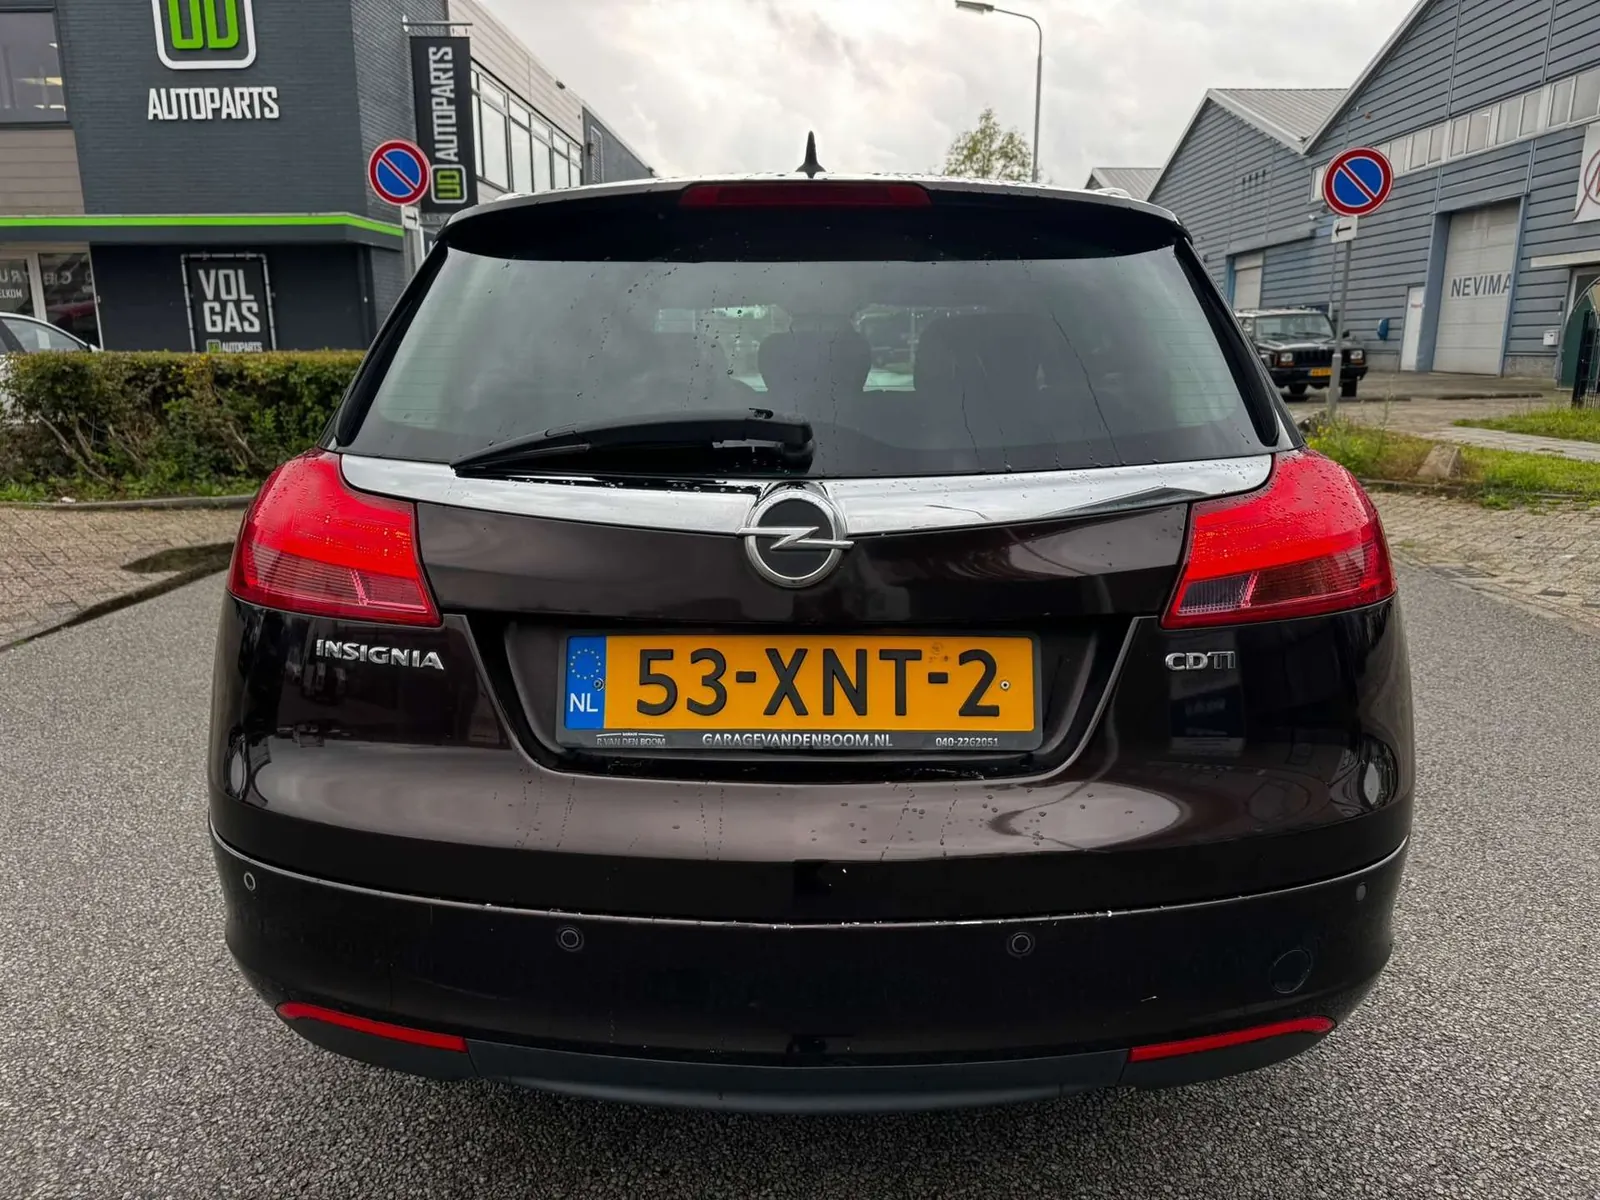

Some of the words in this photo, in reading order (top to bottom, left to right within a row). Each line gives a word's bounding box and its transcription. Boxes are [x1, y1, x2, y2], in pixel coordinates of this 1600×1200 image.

[148, 86, 280, 120] AUTOPARTS
[428, 47, 459, 162] AUTOPARTS
[198, 269, 255, 300] VOL
[1451, 273, 1511, 297] NEVIMA
[203, 301, 261, 333] GAS
[222, 341, 263, 353] AUTOPARTS
[316, 639, 444, 670] INSIGNIA
[636, 648, 1000, 717] 53-XNT-2
[569, 692, 599, 712] NL
[702, 733, 893, 747] GARAGEVANDENBOOM.NL
[935, 737, 999, 747] 040-2262051
